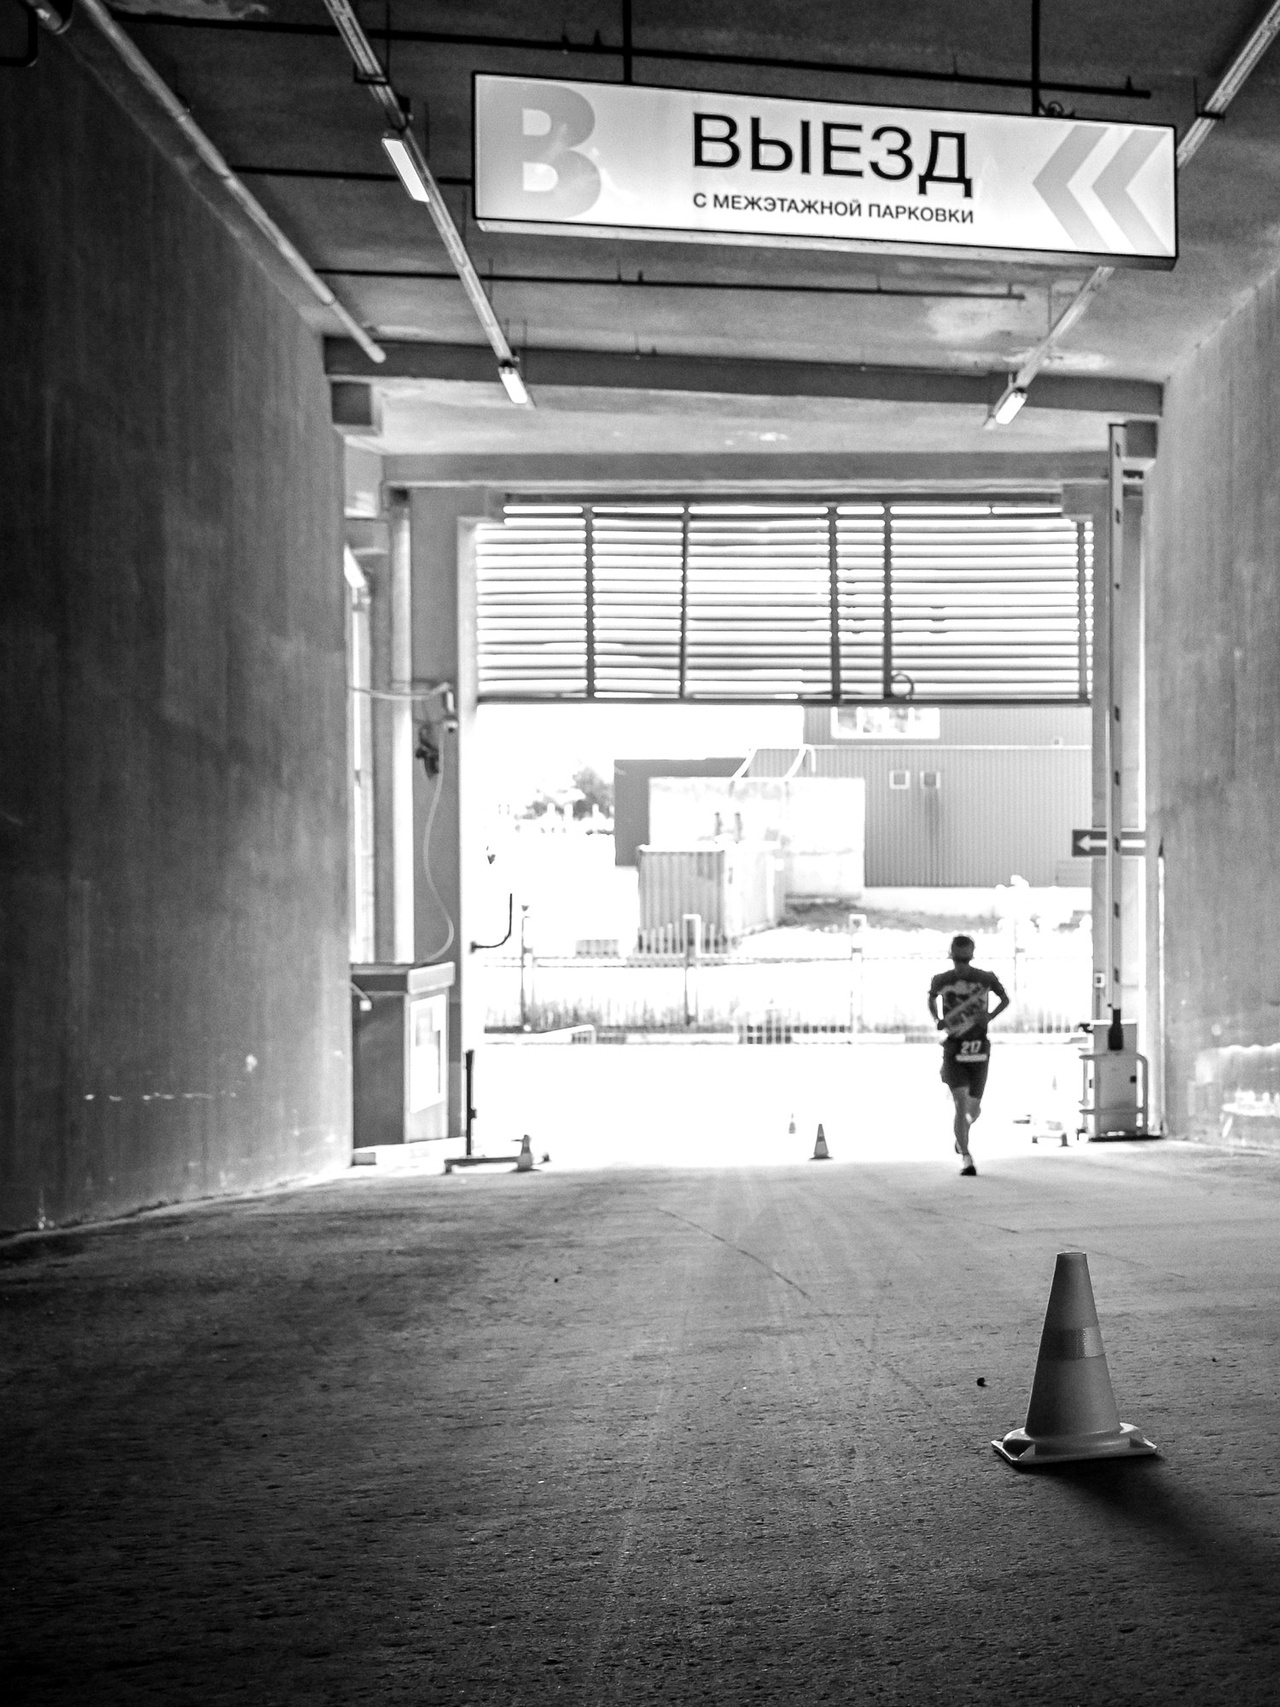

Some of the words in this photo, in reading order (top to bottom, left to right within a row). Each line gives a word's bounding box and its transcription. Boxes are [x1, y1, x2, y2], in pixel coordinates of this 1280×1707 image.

[692, 111, 973, 199] ВЫЕЗД
[692, 192, 708, 208] С
[713, 193, 863, 218] МЕЖЭТАЖНОЙ
[867, 203, 975, 224] ПАРКОВКИ
[960, 1040, 982, 1054] 217
